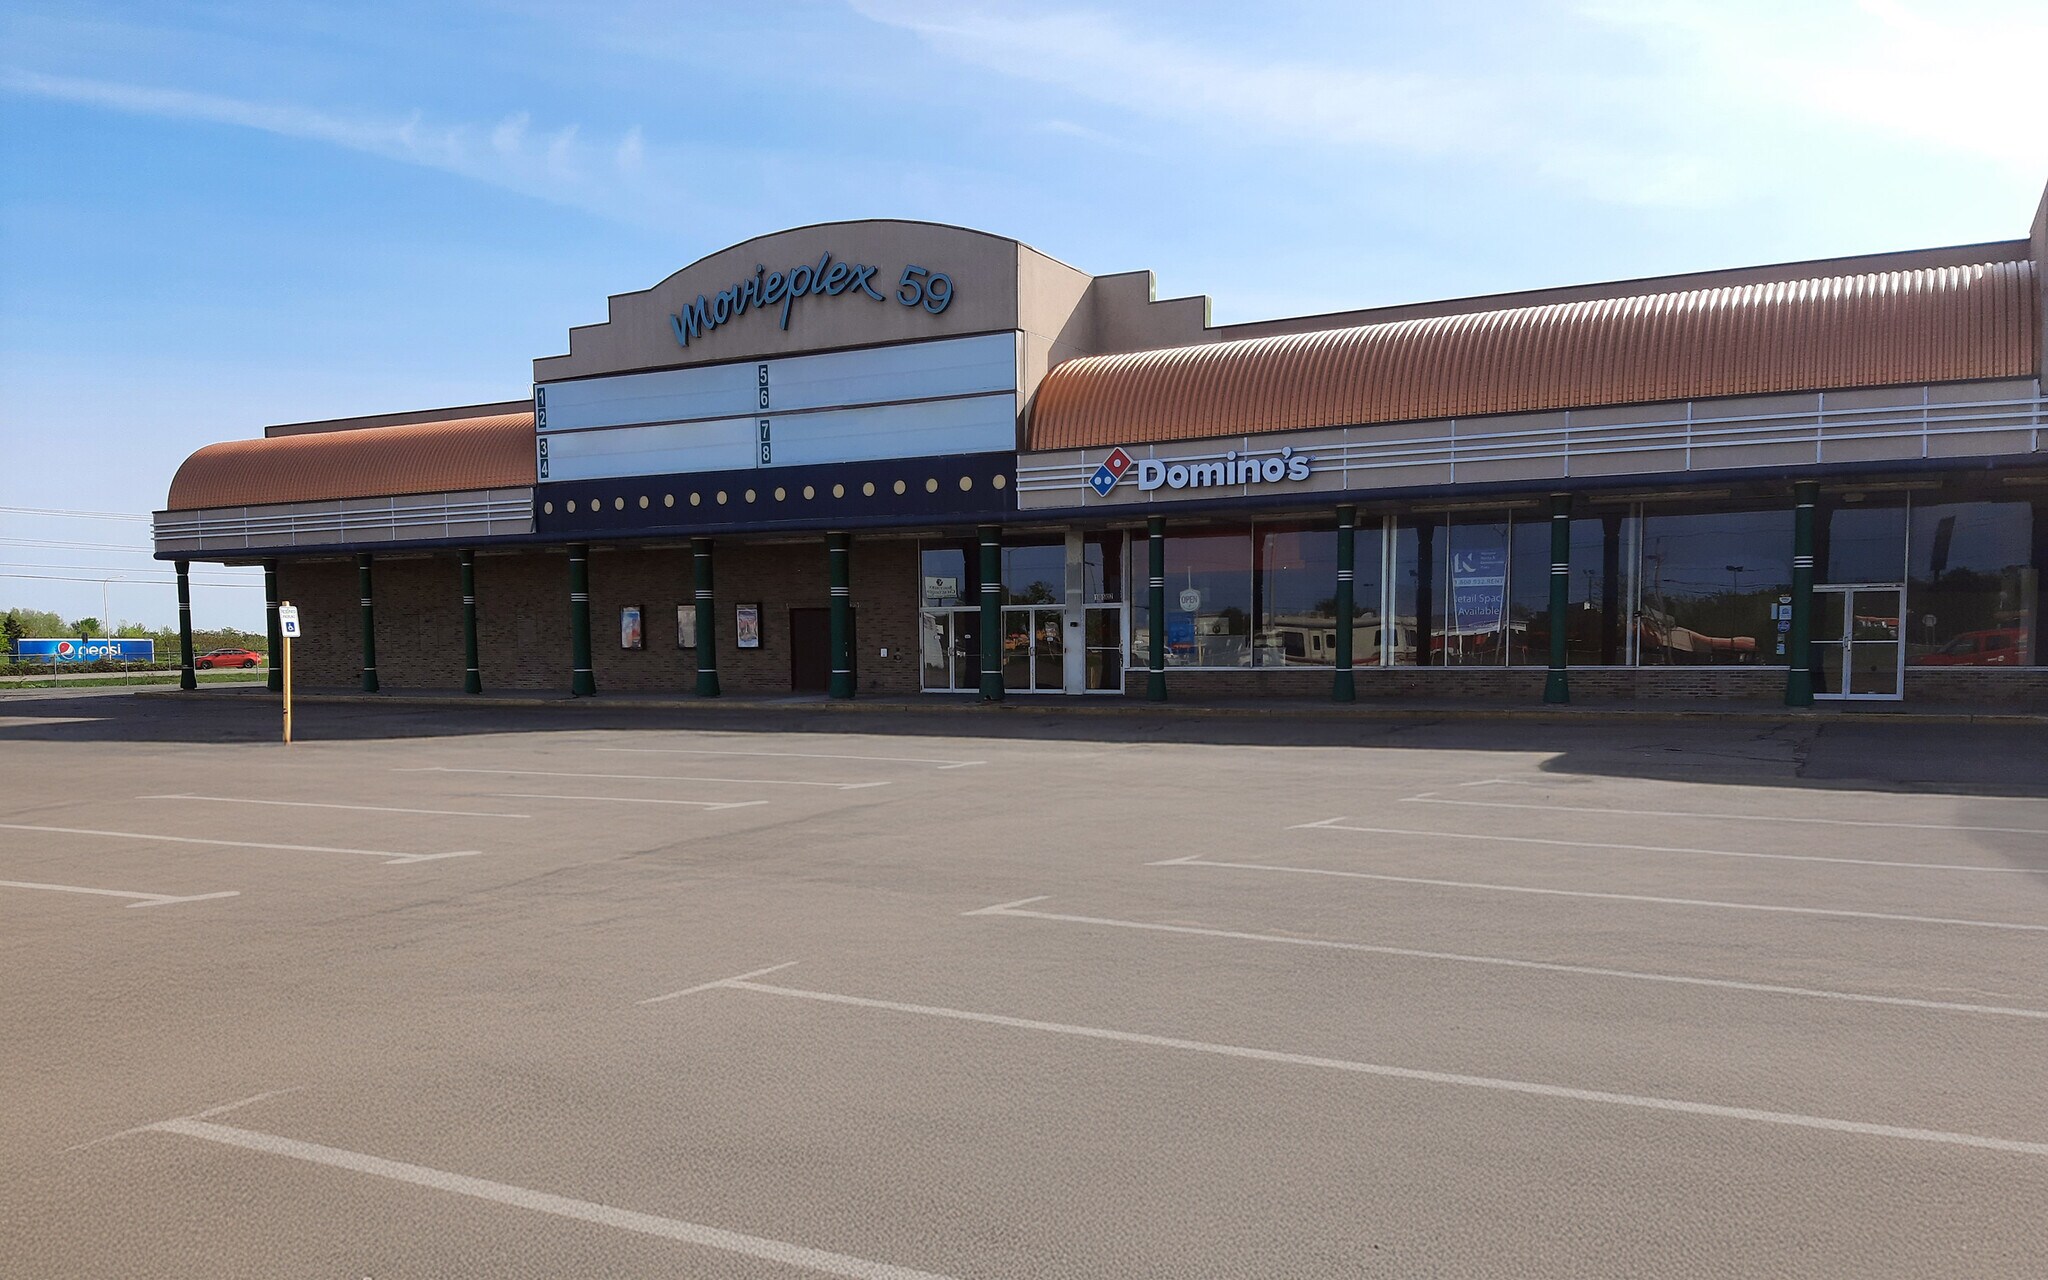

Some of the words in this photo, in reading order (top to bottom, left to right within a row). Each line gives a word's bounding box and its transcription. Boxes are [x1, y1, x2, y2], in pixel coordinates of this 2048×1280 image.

[669, 250, 886, 347] Movieplex
[896, 264, 953, 315] 59
[759, 367, 767, 383] 5
[538, 391, 546, 405] 1
[760, 389, 768, 406] 6
[539, 411, 546, 426] 2
[761, 422, 769, 439] 7
[540, 441, 547, 456] 3
[762, 445, 770, 462] 8
[541, 461, 548, 476] 4
[1138, 446, 1312, 491] Domino's
[1181, 595, 1198, 604] OPEN
[1479, 593, 1503, 604] Spac
[1458, 606, 1500, 616] Available
[78, 643, 121, 659] pepsi
